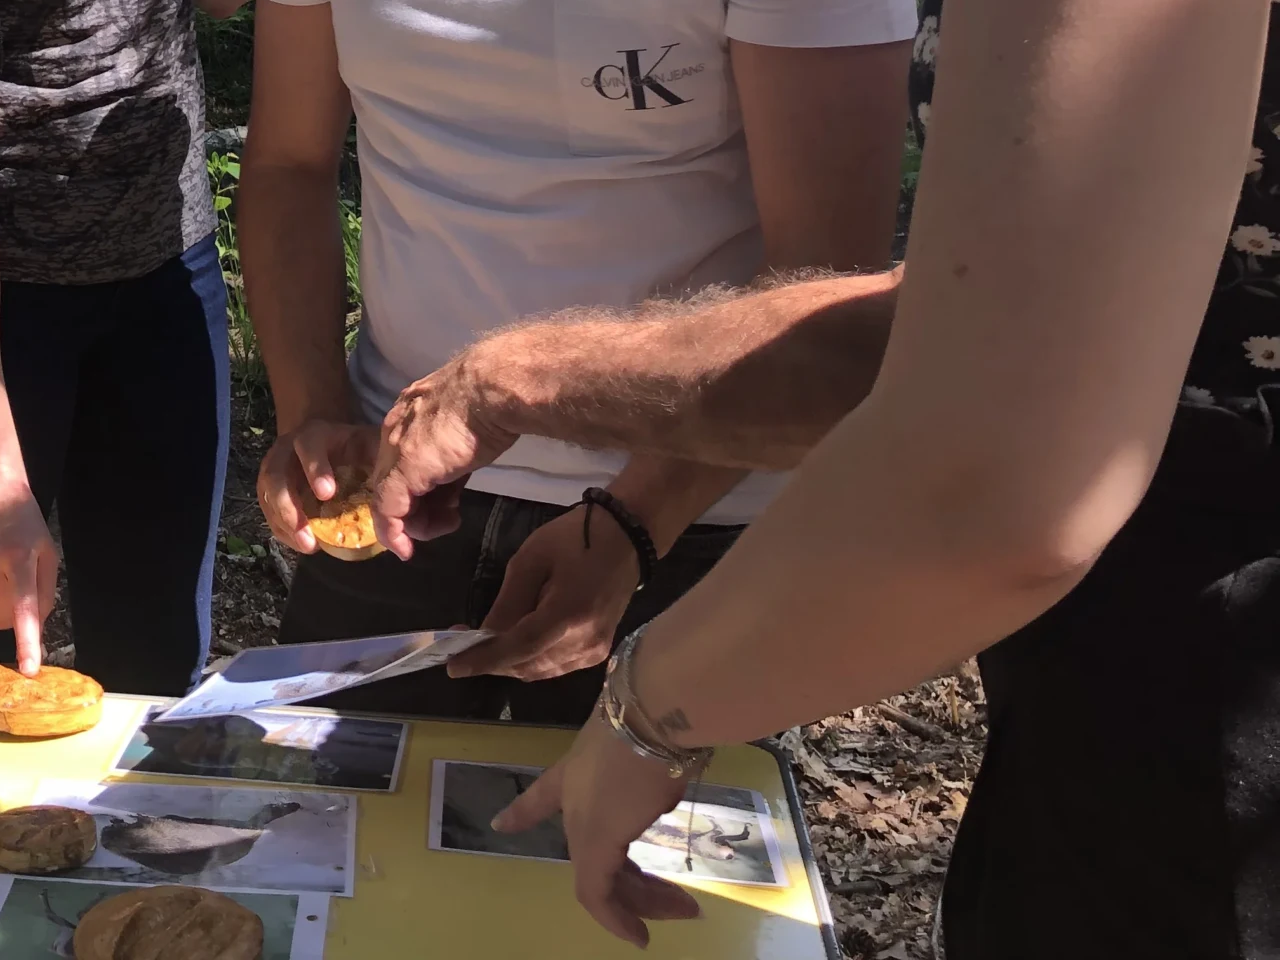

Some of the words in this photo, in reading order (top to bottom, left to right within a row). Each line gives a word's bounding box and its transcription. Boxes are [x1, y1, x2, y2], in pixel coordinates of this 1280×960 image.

[580, 76, 626, 89] CALVIN
[630, 73, 665, 87] KLEIN
[666, 63, 706, 83] JEANS
